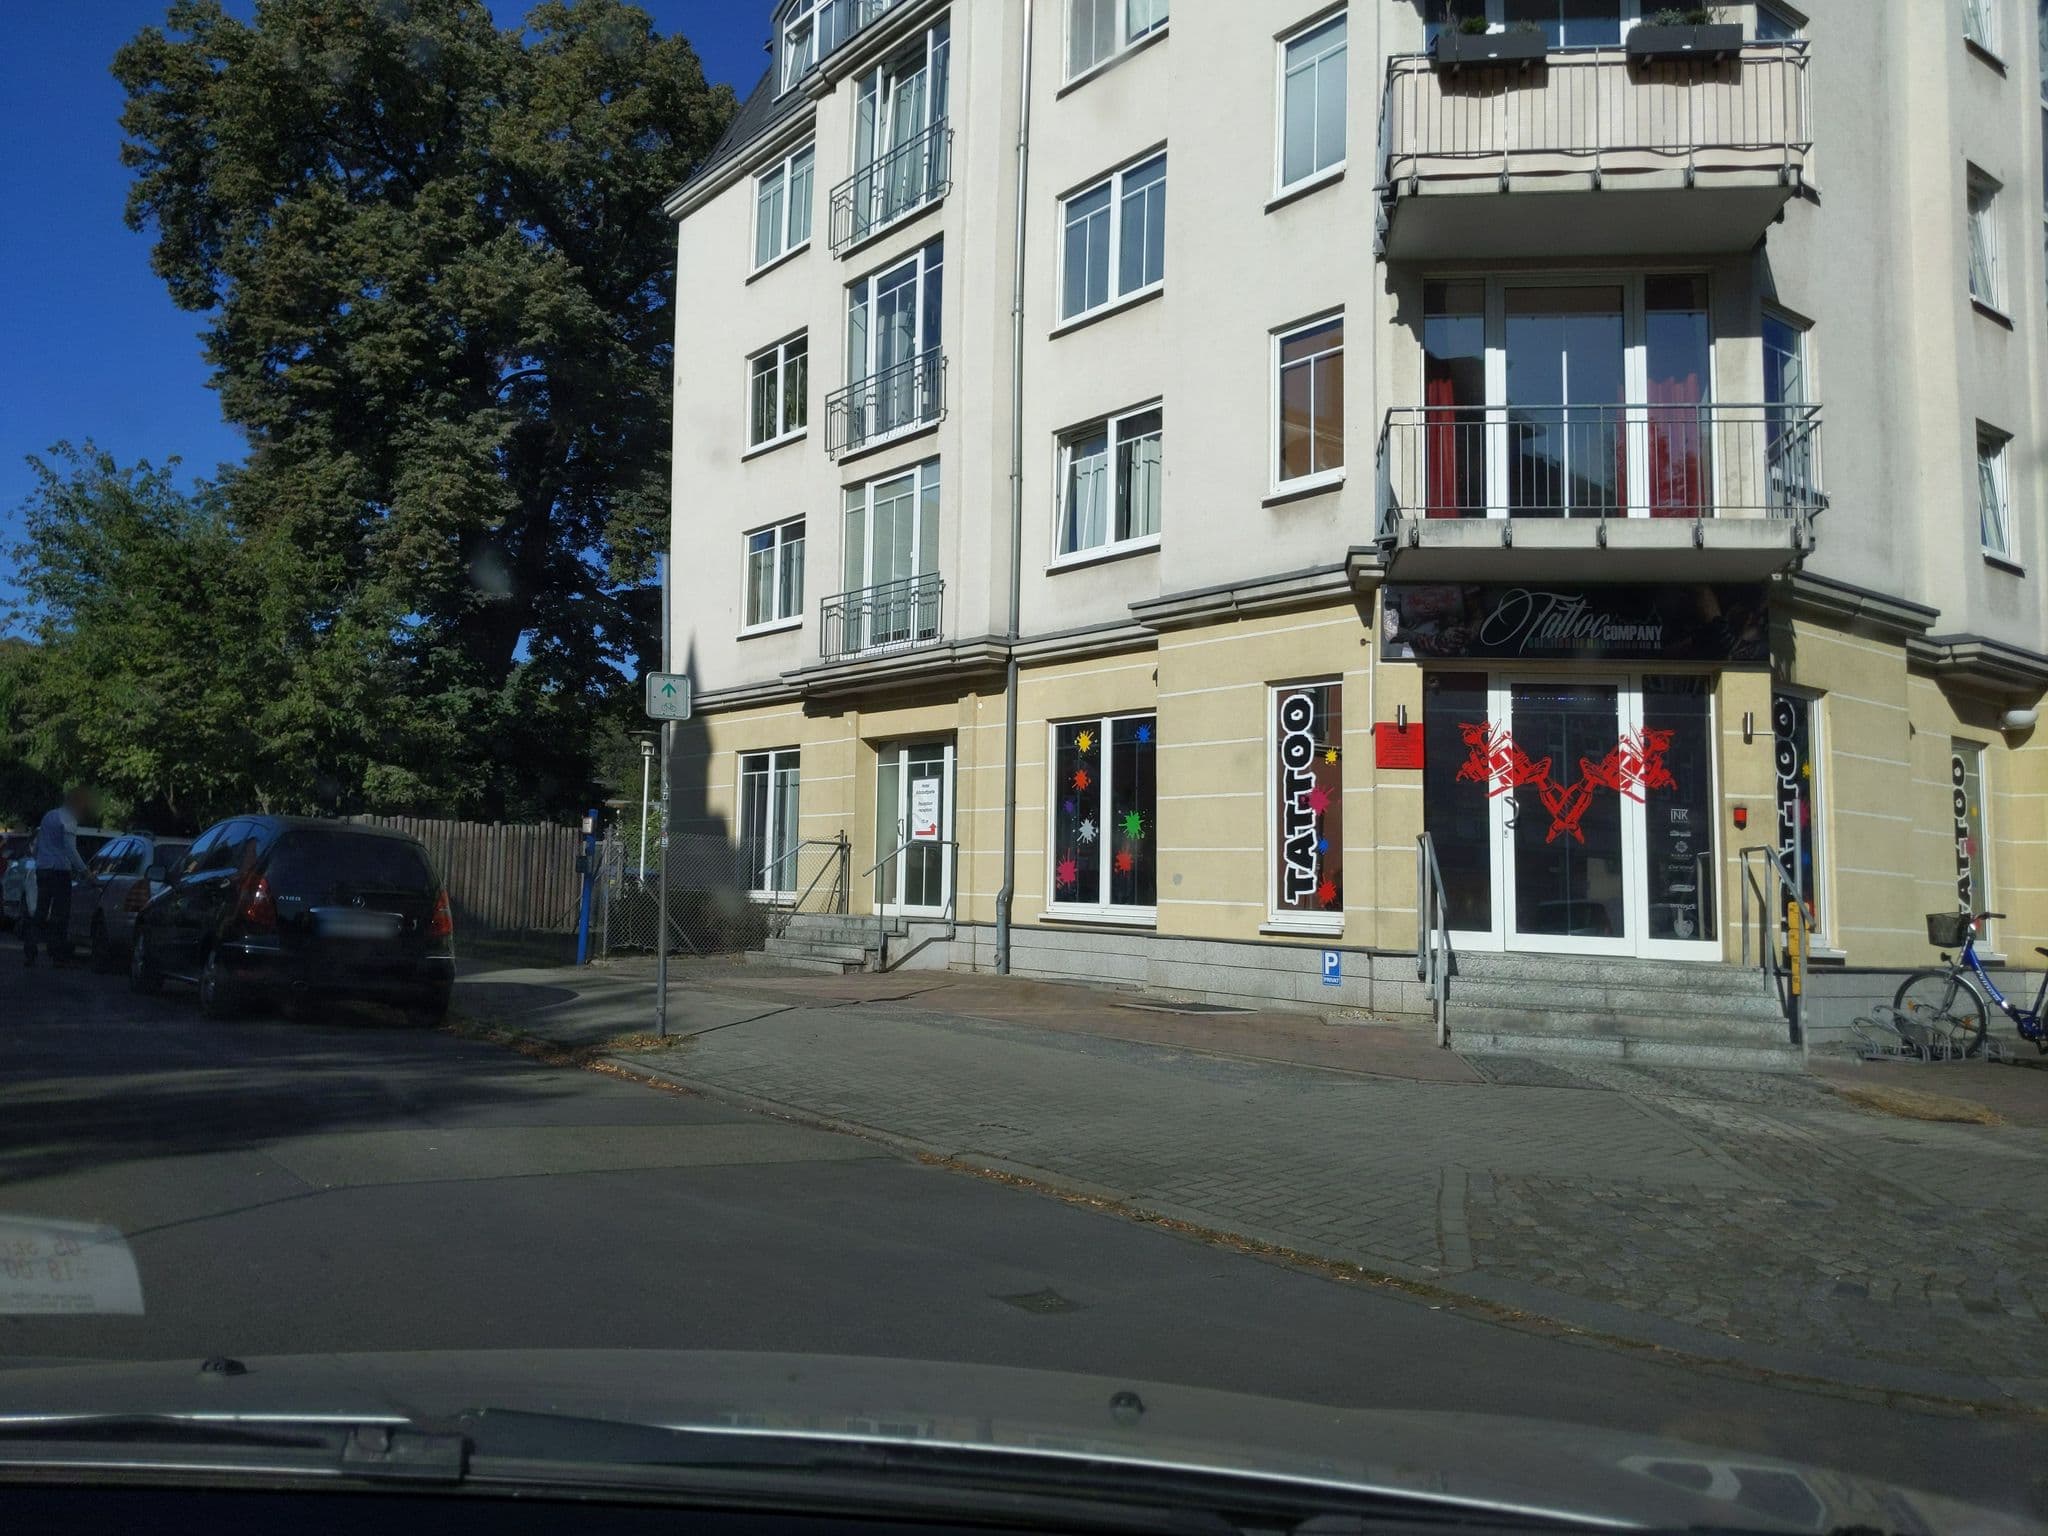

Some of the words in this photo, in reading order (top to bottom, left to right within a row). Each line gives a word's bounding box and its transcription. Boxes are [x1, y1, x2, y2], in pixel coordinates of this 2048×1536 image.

[1603, 625, 1662, 640] COMPANY
[1281, 694, 1316, 905] TATTOO
[1324, 952, 1338, 975] P
